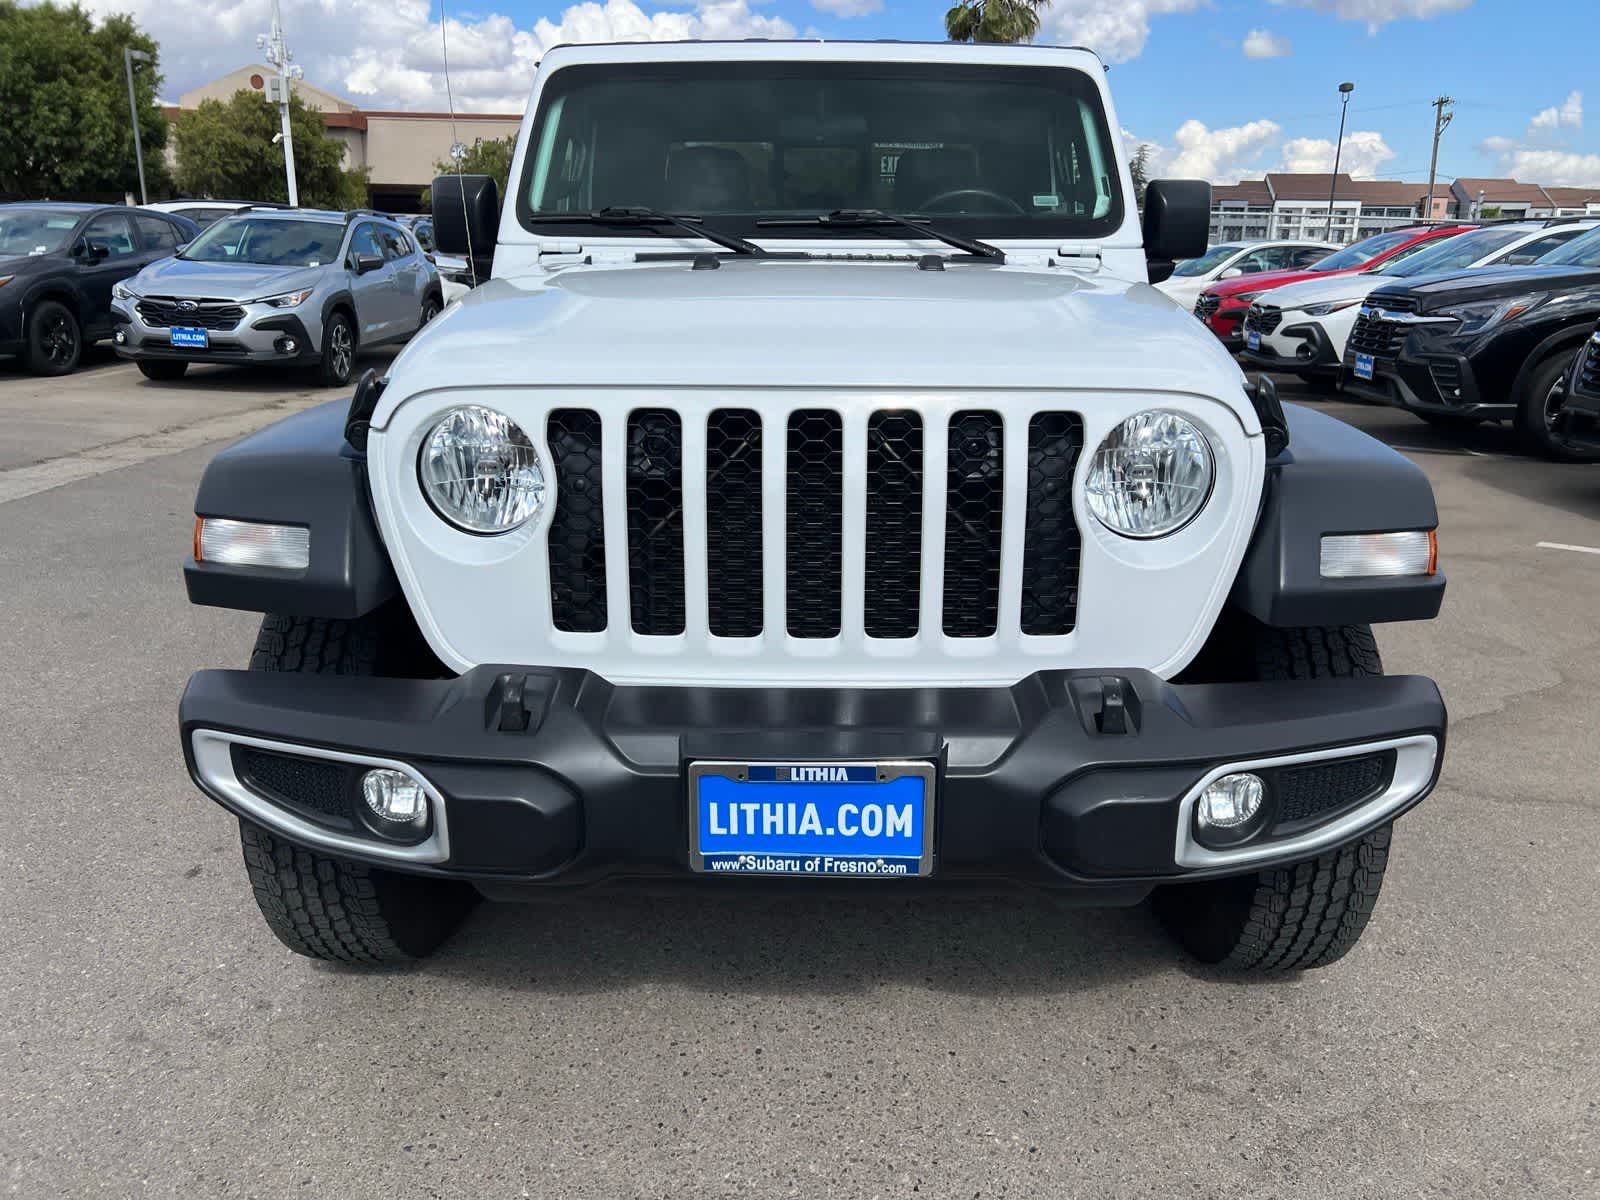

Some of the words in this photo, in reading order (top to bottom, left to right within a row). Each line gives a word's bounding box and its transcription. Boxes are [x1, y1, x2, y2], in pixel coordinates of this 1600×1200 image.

[790, 767, 848, 782] LITHIA
[709, 802, 913, 837] LITHIA.COM
[805, 857, 820, 872] of
